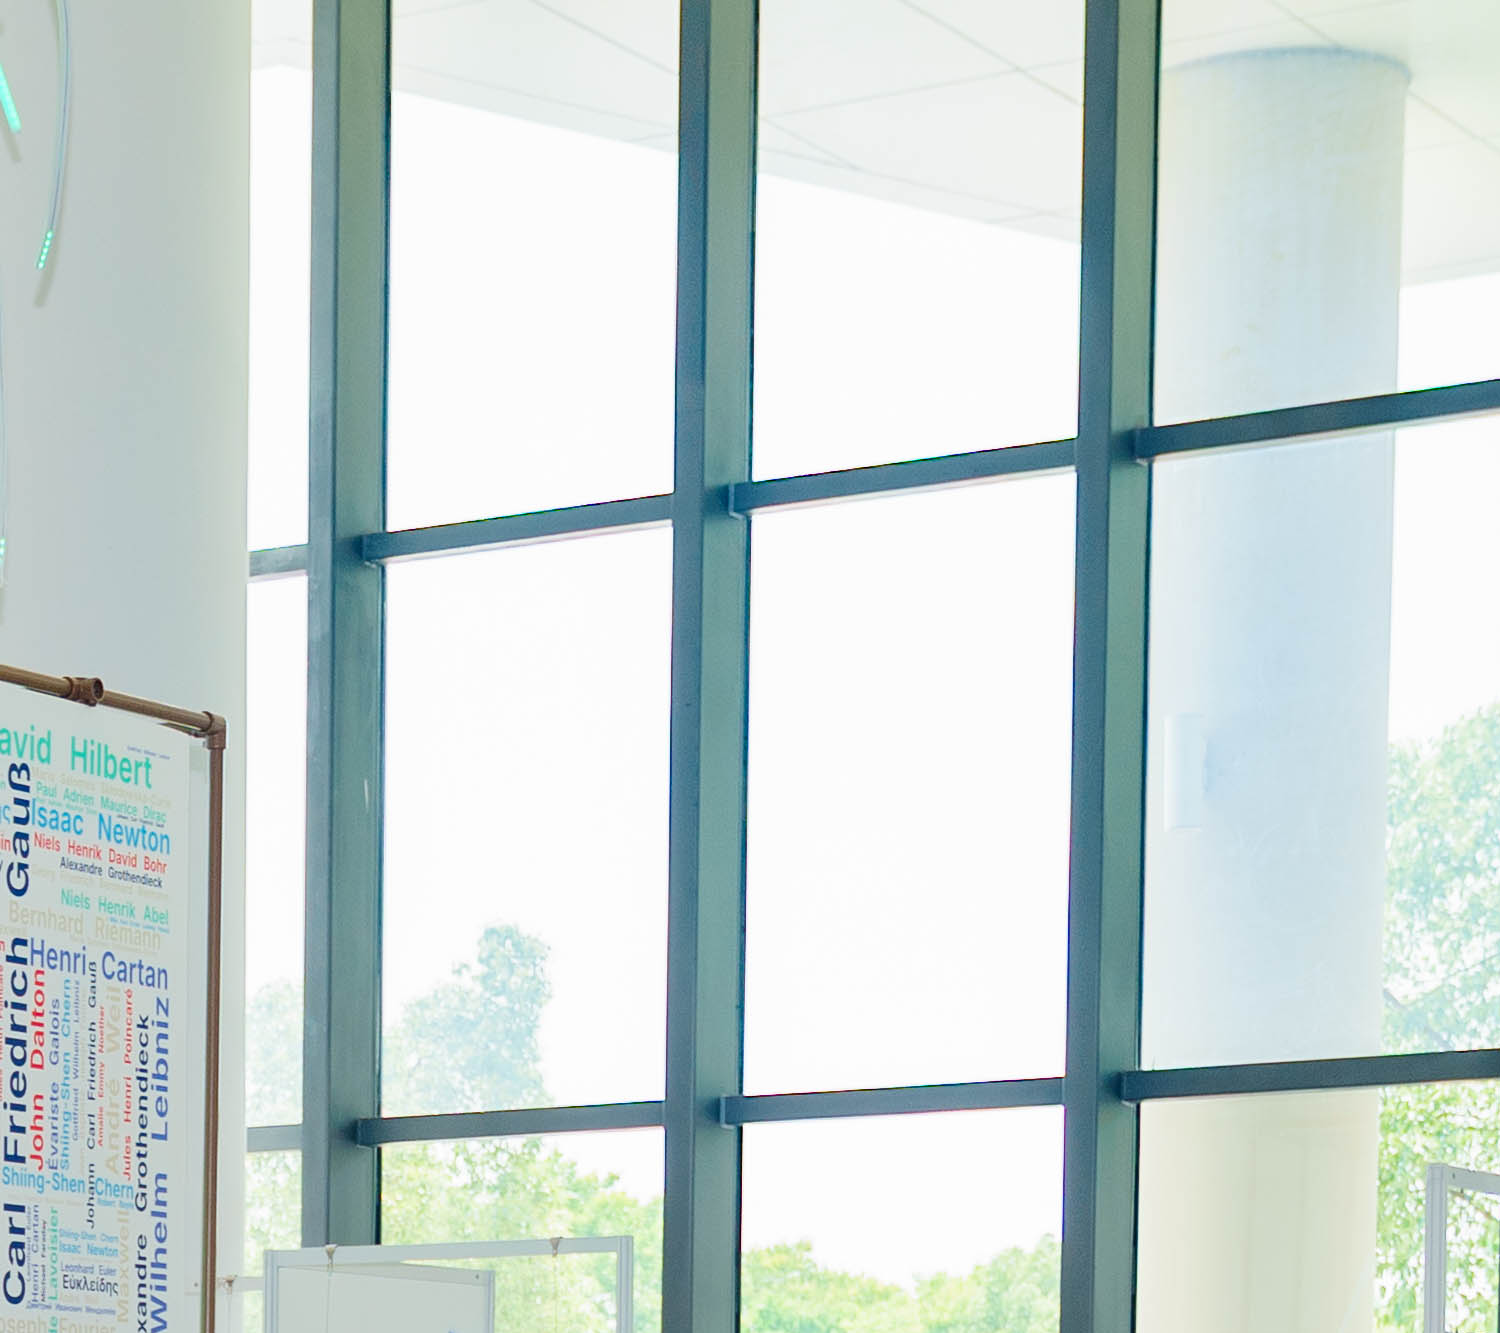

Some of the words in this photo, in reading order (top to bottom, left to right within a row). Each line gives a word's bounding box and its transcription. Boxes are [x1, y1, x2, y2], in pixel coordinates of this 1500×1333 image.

[71, 735, 153, 788] Hilbert
[6, 763, 31, 897] Gauß
[32, 798, 84, 836] Isaac
[98, 813, 171, 855] Newton
[36, 781, 57, 798] Paul
[64, 788, 95, 807] Adrien
[101, 796, 138, 815] Maurice
[143, 806, 167, 824] Dirac
[34, 832, 61, 852] Niels
[68, 840, 102, 860] Henrik
[109, 848, 137, 868] David
[144, 856, 168, 874] Bohr
[60, 856, 103, 877] Alexandre
[108, 867, 163, 889] Grothendieck
[9, 900, 83, 936] Bernhard
[96, 917, 161, 950] Riemann
[61, 888, 91, 910] Niels
[98, 896, 136, 919] Henrik
[143, 905, 169, 926] Abel
[31, 937, 86, 976] Henri
[101, 951, 168, 990] Cartan
[87, 961, 97, 1008] Gauß
[31, 969, 45, 1070] Dalton
[49, 998, 60, 1065] Galois
[60, 979, 71, 1038] Chern
[104, 985, 121, 1053] Weil
[123, 988, 133, 1065] Poincaré
[3, 937, 28, 1164] Friedrich
[87, 1021, 97, 1100] Friedrich
[150, 996, 169, 1141] Leibniz
[46, 1082, 60, 1170] Évariste
[60, 1052, 72, 1170] Shiing-Shen
[105, 1079, 120, 1174] André
[123, 1076, 133, 1123] Henri
[135, 1014, 149, 1212] Grothendieck
[30, 1094, 45, 1172] John
[86, 1113, 96, 1150] Carl
[123, 1135, 131, 1181] Jules
[2, 1166, 86, 1194] Shiing-Shen
[94, 1177, 134, 1199] Chern
[86, 1163, 95, 1229] Johann
[3, 1203, 26, 1305] Carl
[31, 1204, 39, 1254] Cartan
[48, 1207, 58, 1300] Lavoisier
[59, 1242, 81, 1256] Isaac
[87, 1244, 118, 1257] Newton
[31, 1263, 39, 1303] Henri
[117, 1210, 129, 1323] Maxwell
